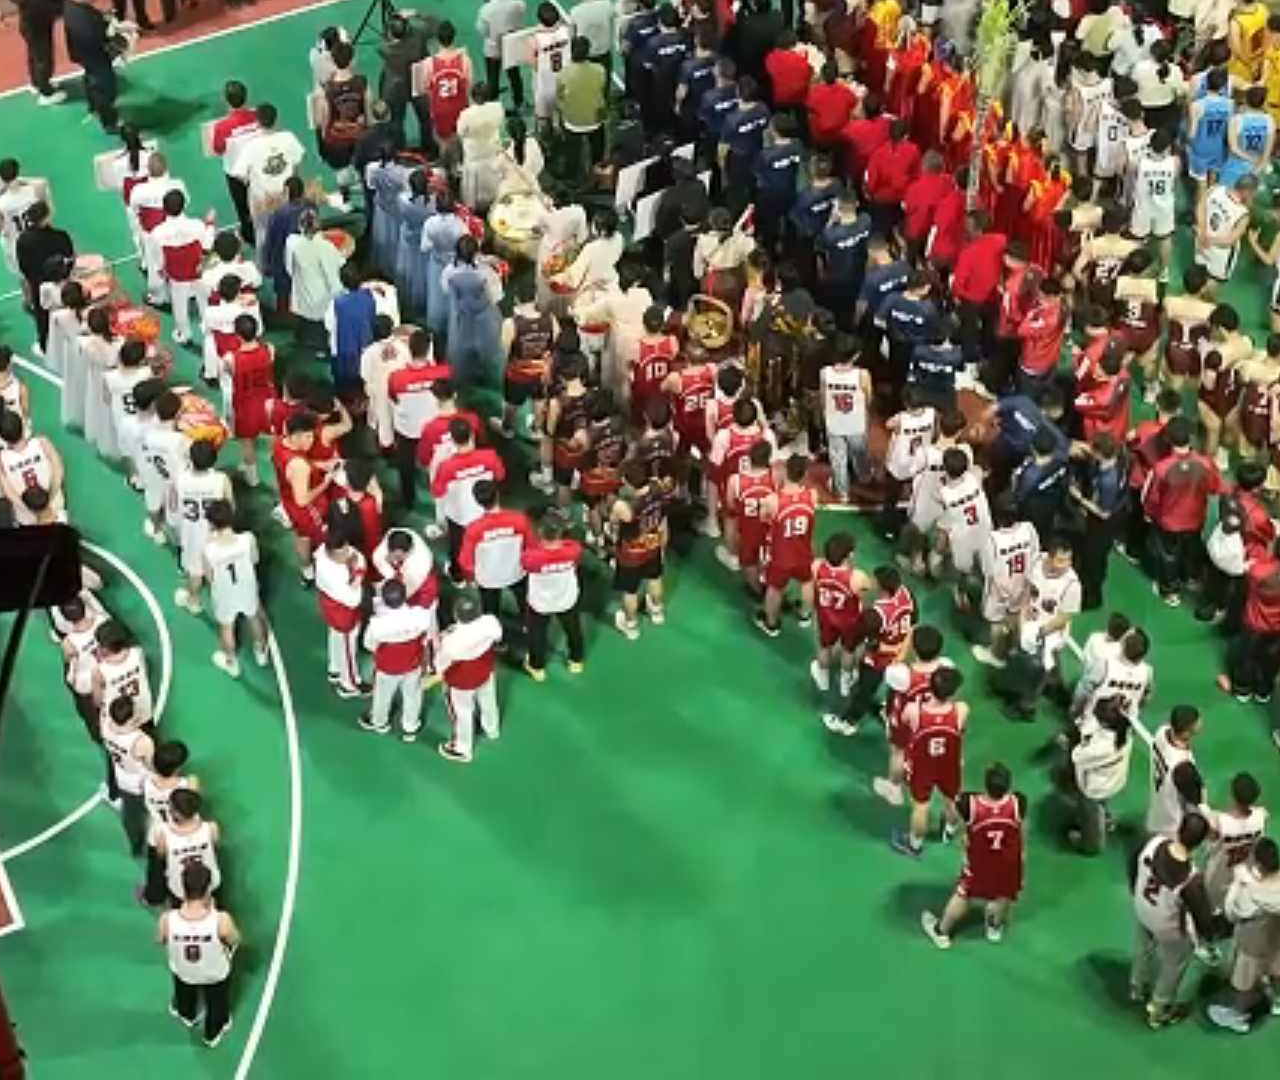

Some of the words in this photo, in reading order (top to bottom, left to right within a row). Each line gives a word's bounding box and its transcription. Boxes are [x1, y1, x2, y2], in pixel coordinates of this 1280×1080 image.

[962, 505, 977, 527] 3
[783, 516, 807, 538] 19
[226, 564, 238, 584] 1
[987, 831, 1005, 850] 7
